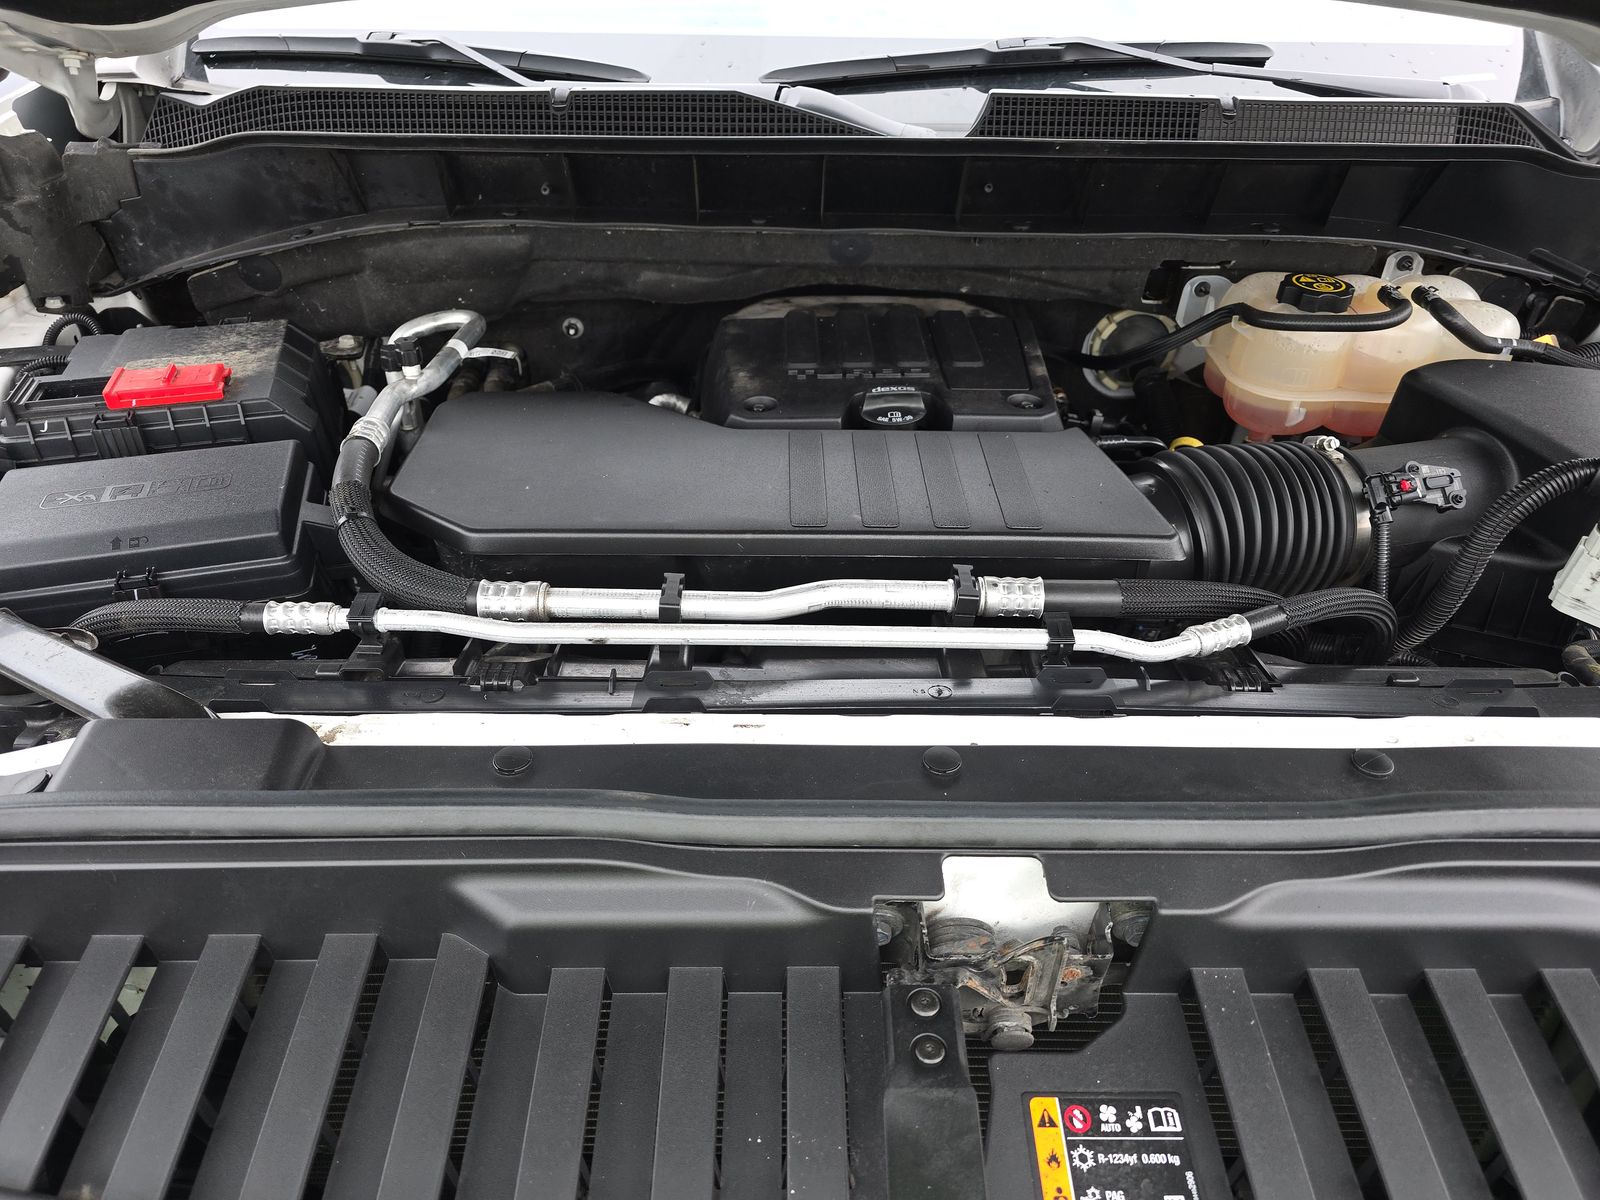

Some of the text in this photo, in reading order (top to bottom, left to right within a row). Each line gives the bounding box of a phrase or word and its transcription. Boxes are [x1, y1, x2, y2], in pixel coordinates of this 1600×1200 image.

[1100, 1123, 1122, 1132] AUTO
[1097, 1153, 1181, 1166] R-1234yf 0.600 kg
[1105, 1190, 1126, 1200] PAG
